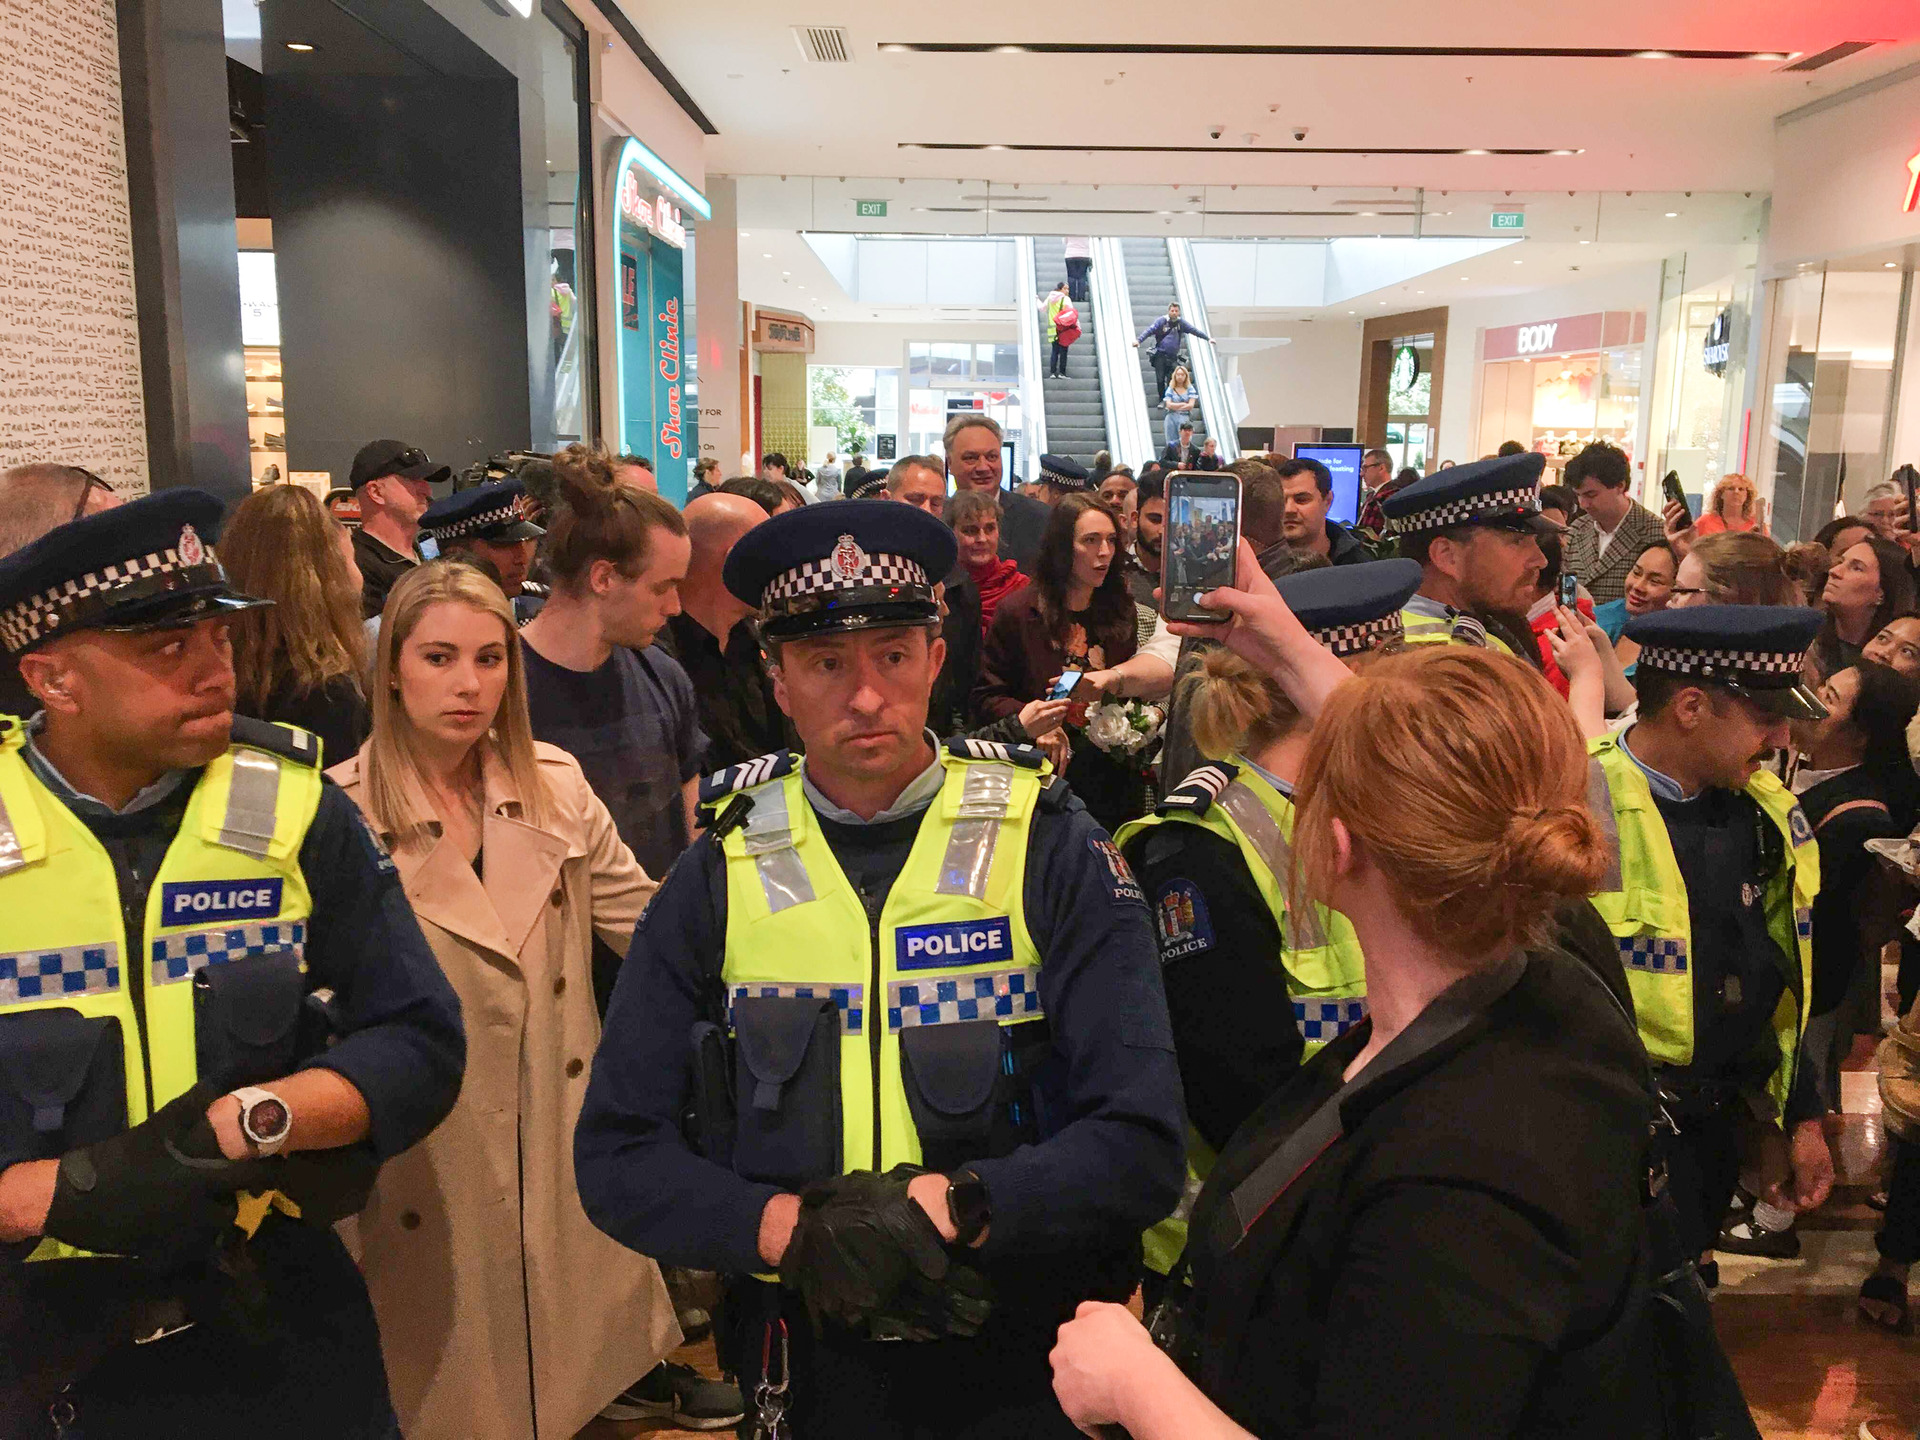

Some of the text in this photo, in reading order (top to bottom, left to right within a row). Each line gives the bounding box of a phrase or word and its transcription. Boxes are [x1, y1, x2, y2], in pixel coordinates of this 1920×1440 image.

[862, 203, 881, 215] EXIT
[1498, 215, 1518, 226] EXIT
[1518, 323, 1557, 353] BODY
[658, 296, 682, 459] Shoe Clinic
[174, 889, 272, 913] POLICE
[1113, 888, 1145, 900] POLIC
[907, 929, 1003, 957] POLICE
[1160, 937, 1207, 963] POLICE
